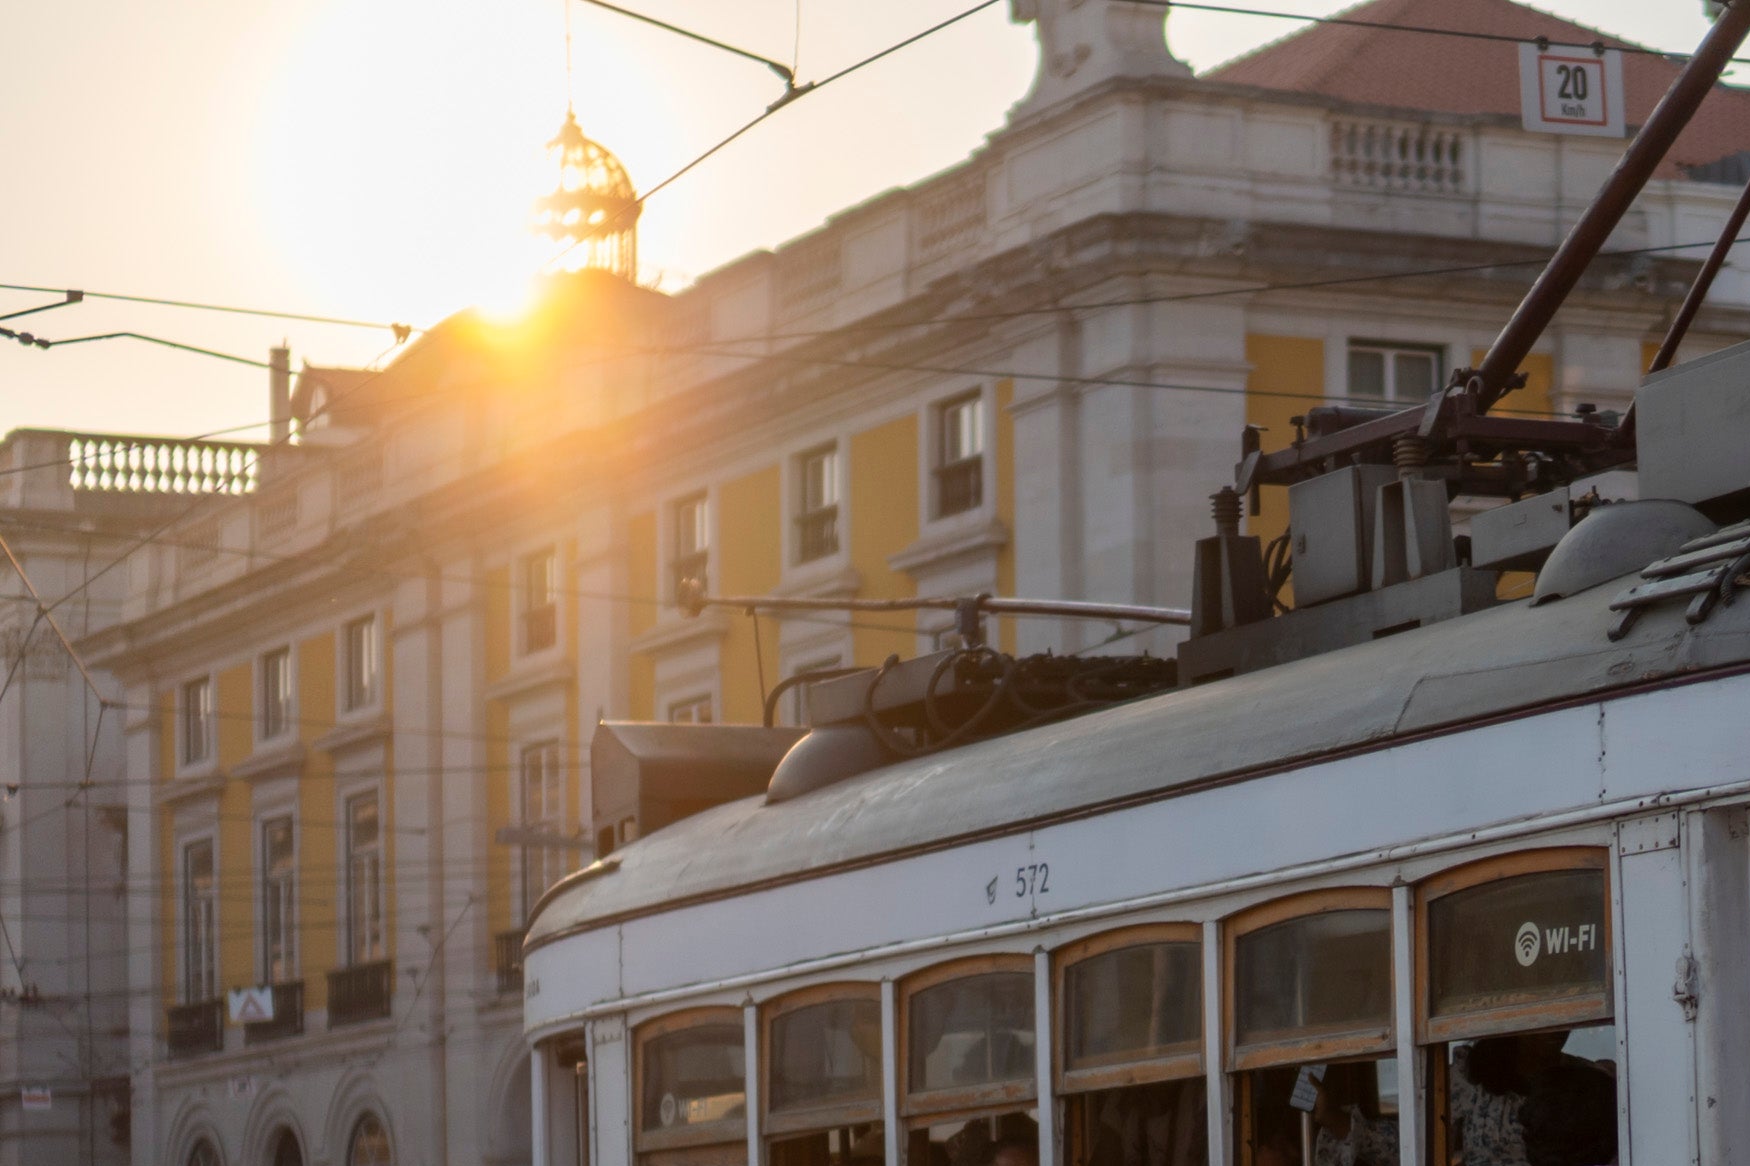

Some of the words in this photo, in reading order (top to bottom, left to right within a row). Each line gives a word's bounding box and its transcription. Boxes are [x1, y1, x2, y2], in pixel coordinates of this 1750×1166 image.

[1557, 64, 1588, 100] 20
[1560, 103, 1587, 118] Km/h
[1016, 862, 1049, 898] 572
[1545, 923, 1596, 955] WI-FI
